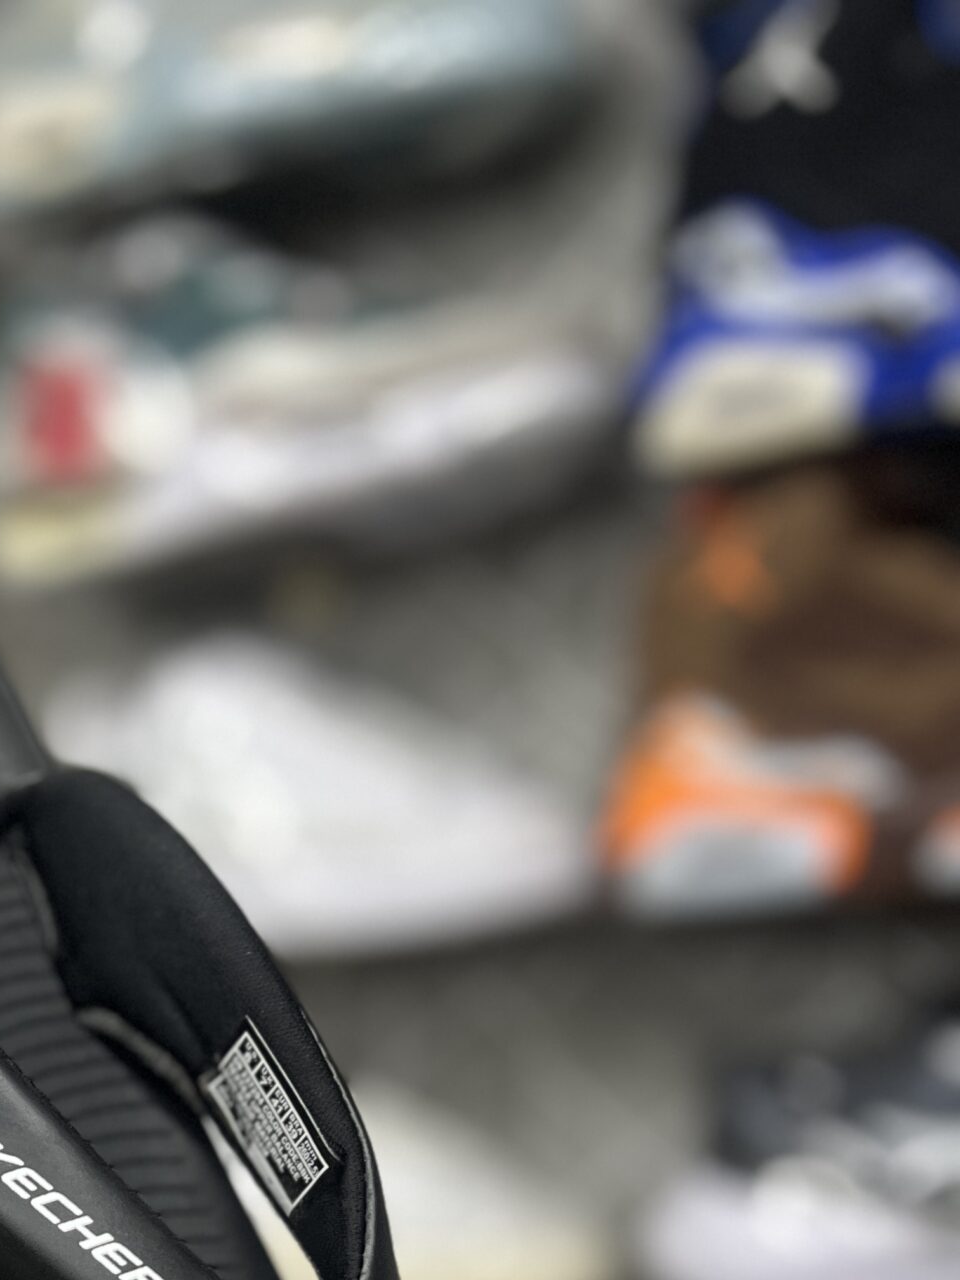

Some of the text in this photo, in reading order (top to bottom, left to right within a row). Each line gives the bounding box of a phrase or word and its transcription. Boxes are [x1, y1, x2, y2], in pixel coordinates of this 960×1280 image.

[269, 1095, 283, 1115] 41
[274, 1088, 289, 1111] EUR
[261, 1104, 282, 1137] COLOR
[284, 1120, 298, 1141] 39
[288, 1112, 303, 1135] BRA
[269, 1133, 300, 1181] BALANCE
